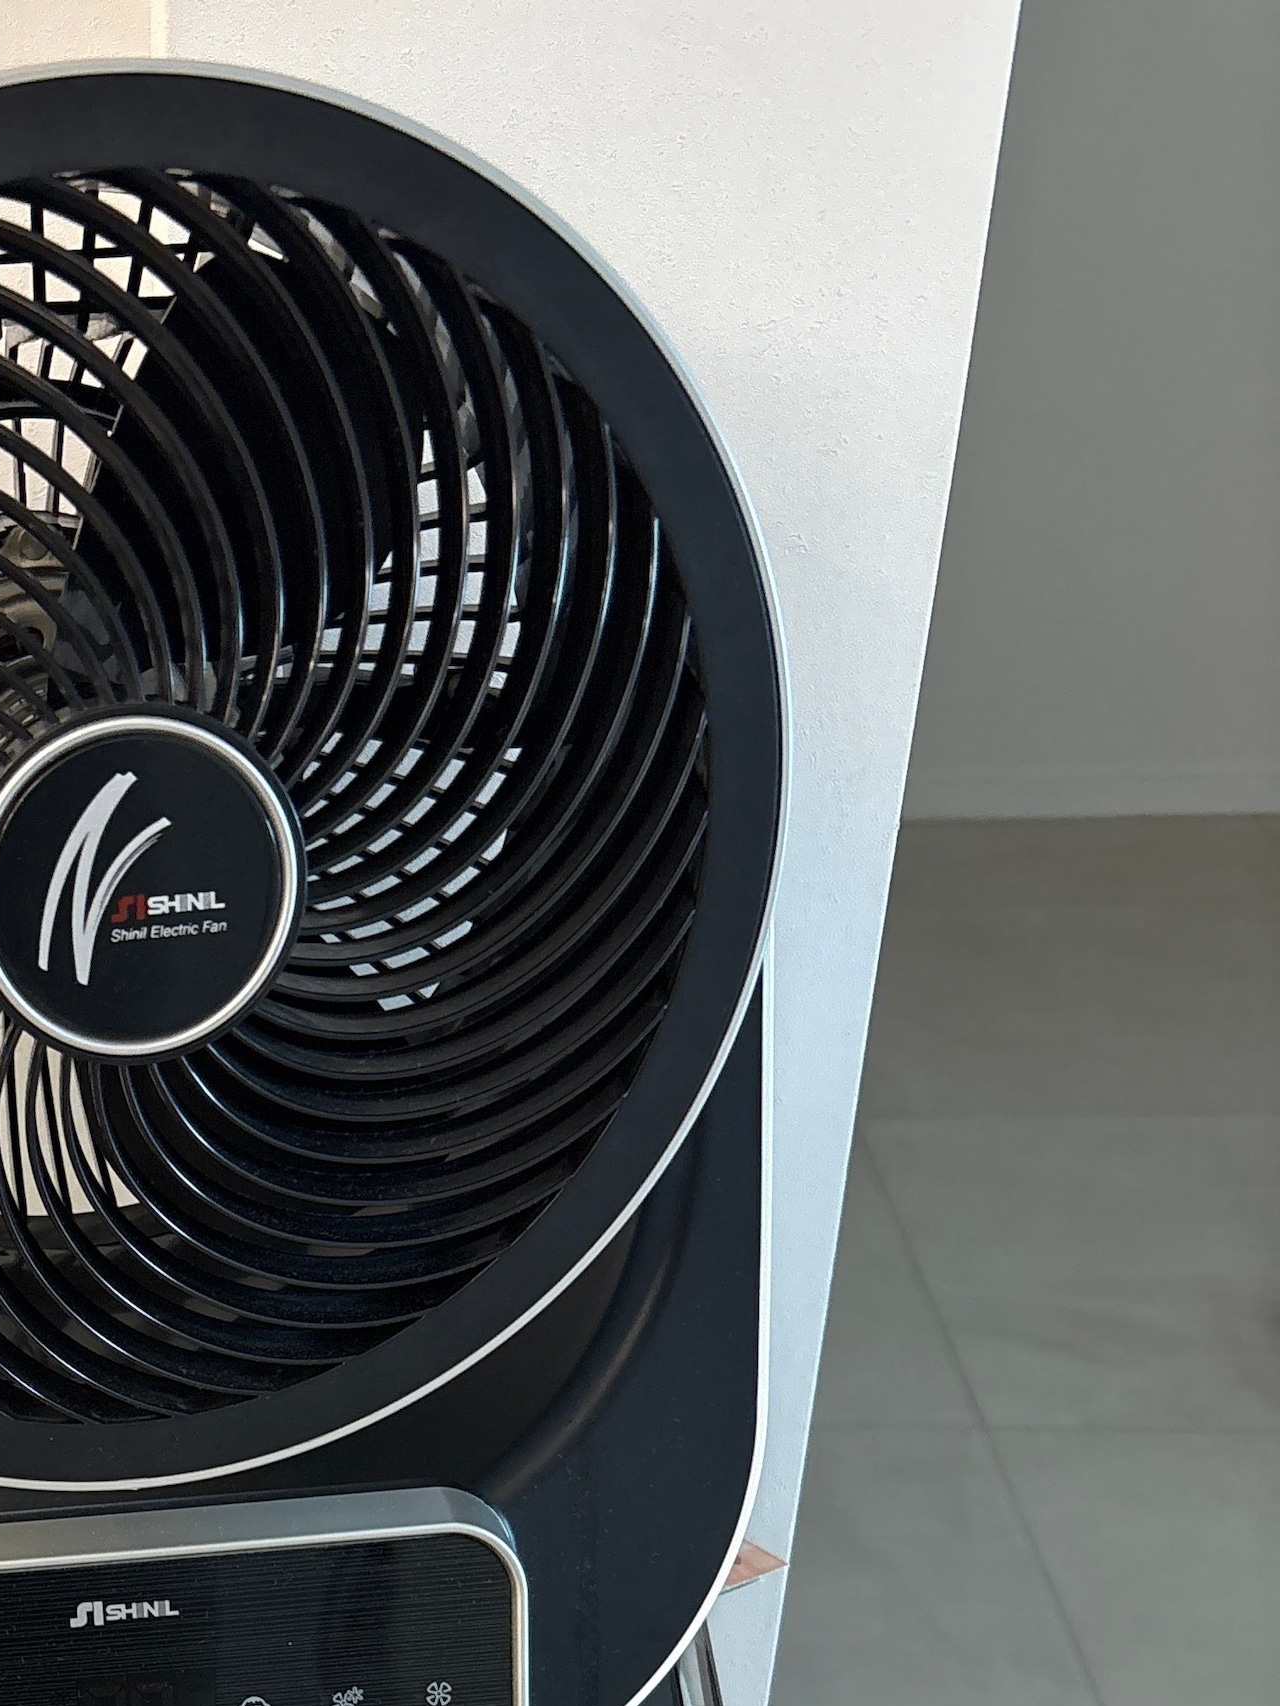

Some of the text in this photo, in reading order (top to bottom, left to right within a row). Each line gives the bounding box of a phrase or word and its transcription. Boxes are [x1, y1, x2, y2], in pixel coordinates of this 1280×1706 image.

[110, 920, 228, 943] Shinil Electric Fan
